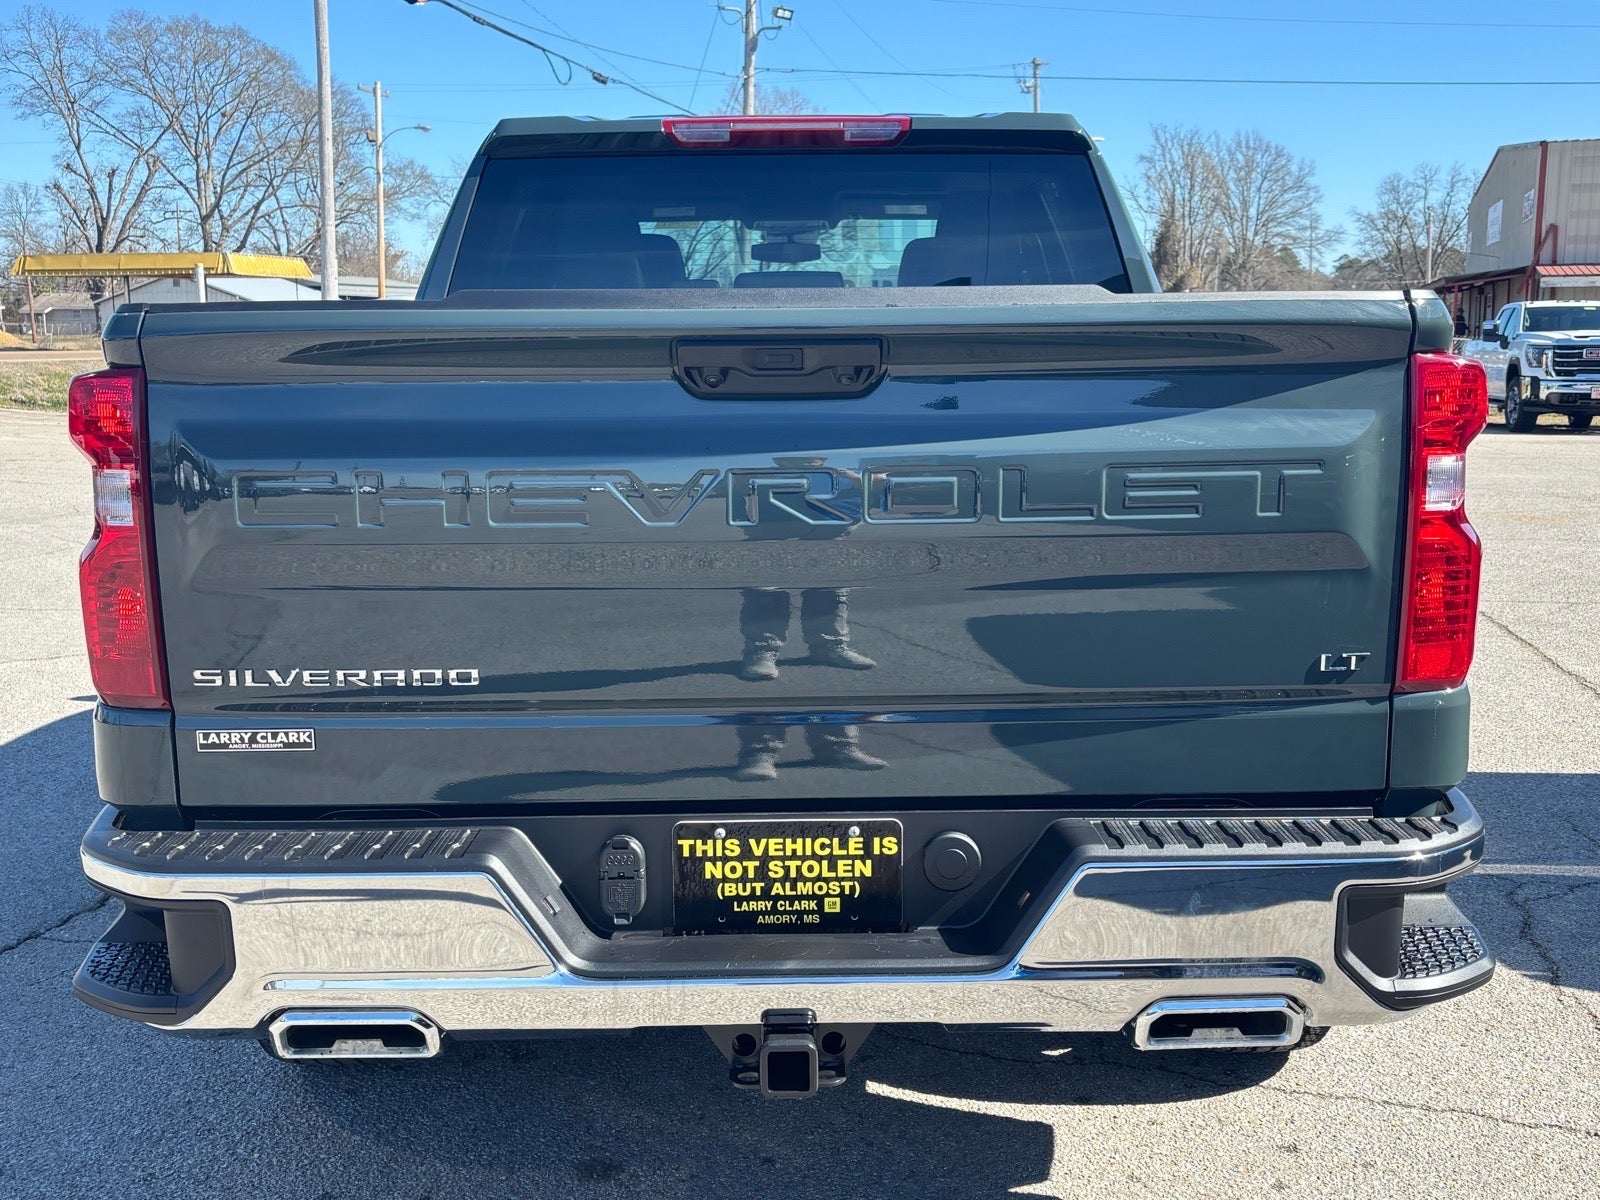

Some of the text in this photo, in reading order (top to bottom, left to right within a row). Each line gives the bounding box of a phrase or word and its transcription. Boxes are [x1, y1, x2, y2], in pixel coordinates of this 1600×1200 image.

[232, 460, 1325, 528] CHEVROLET
[1320, 652, 1371, 671] LT
[192, 668, 480, 687] SILVERADO
[199, 731, 312, 743] LARRY CLARK
[677, 837, 898, 857] THIS VEHICLE IS
[704, 859, 872, 879] NOT STOLEN
[716, 881, 861, 899] (BUT ALMOST)
[733, 901, 773, 912] LARRY
[777, 900, 818, 911] CLARK
[757, 914, 820, 924] AMORY, MS
